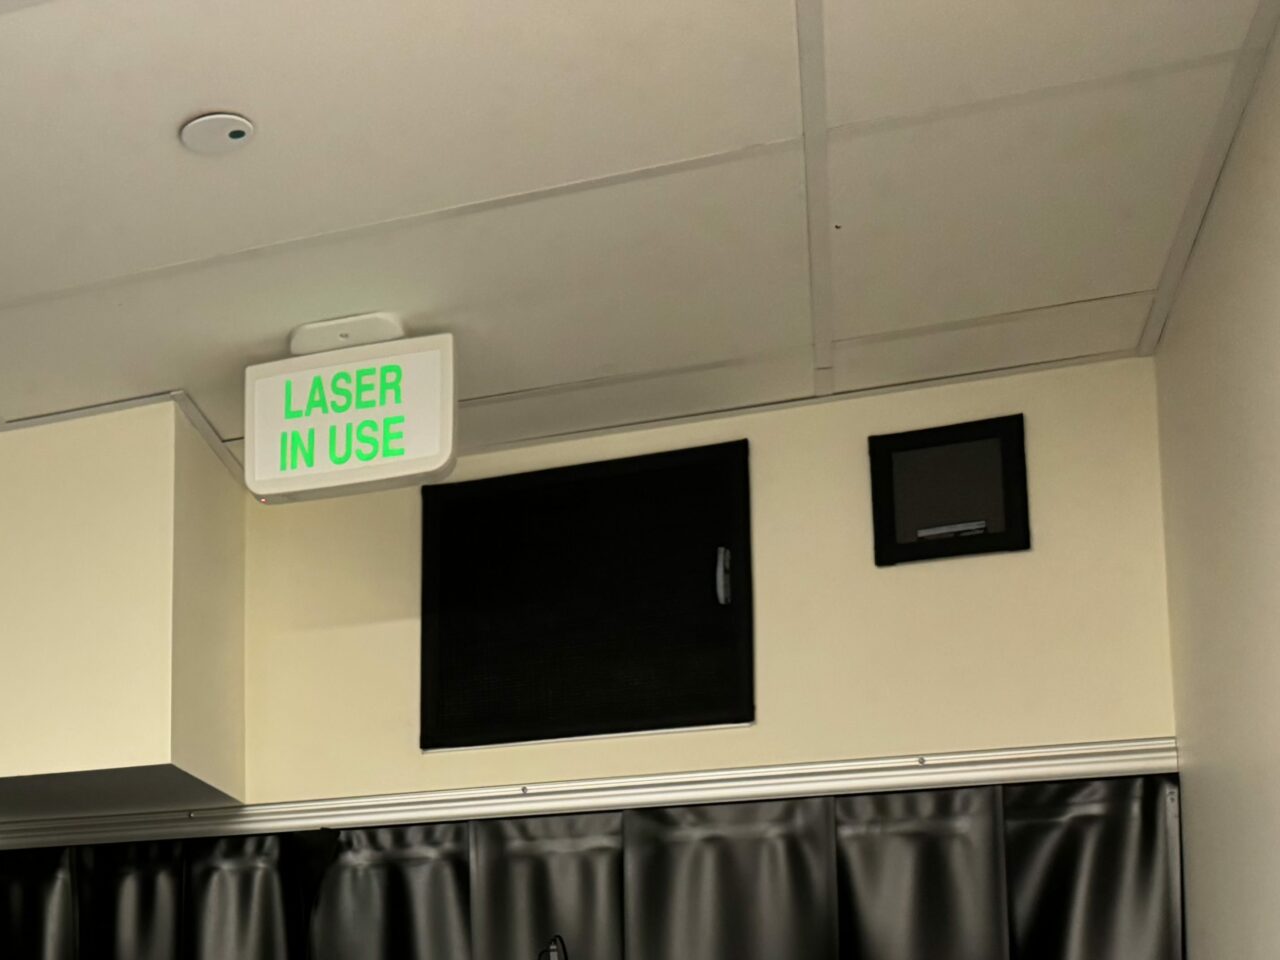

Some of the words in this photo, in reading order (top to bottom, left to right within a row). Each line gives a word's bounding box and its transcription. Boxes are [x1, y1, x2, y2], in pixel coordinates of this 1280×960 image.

[284, 365, 402, 419] LASER
[280, 428, 315, 472] IN
[329, 417, 403, 465] USE
